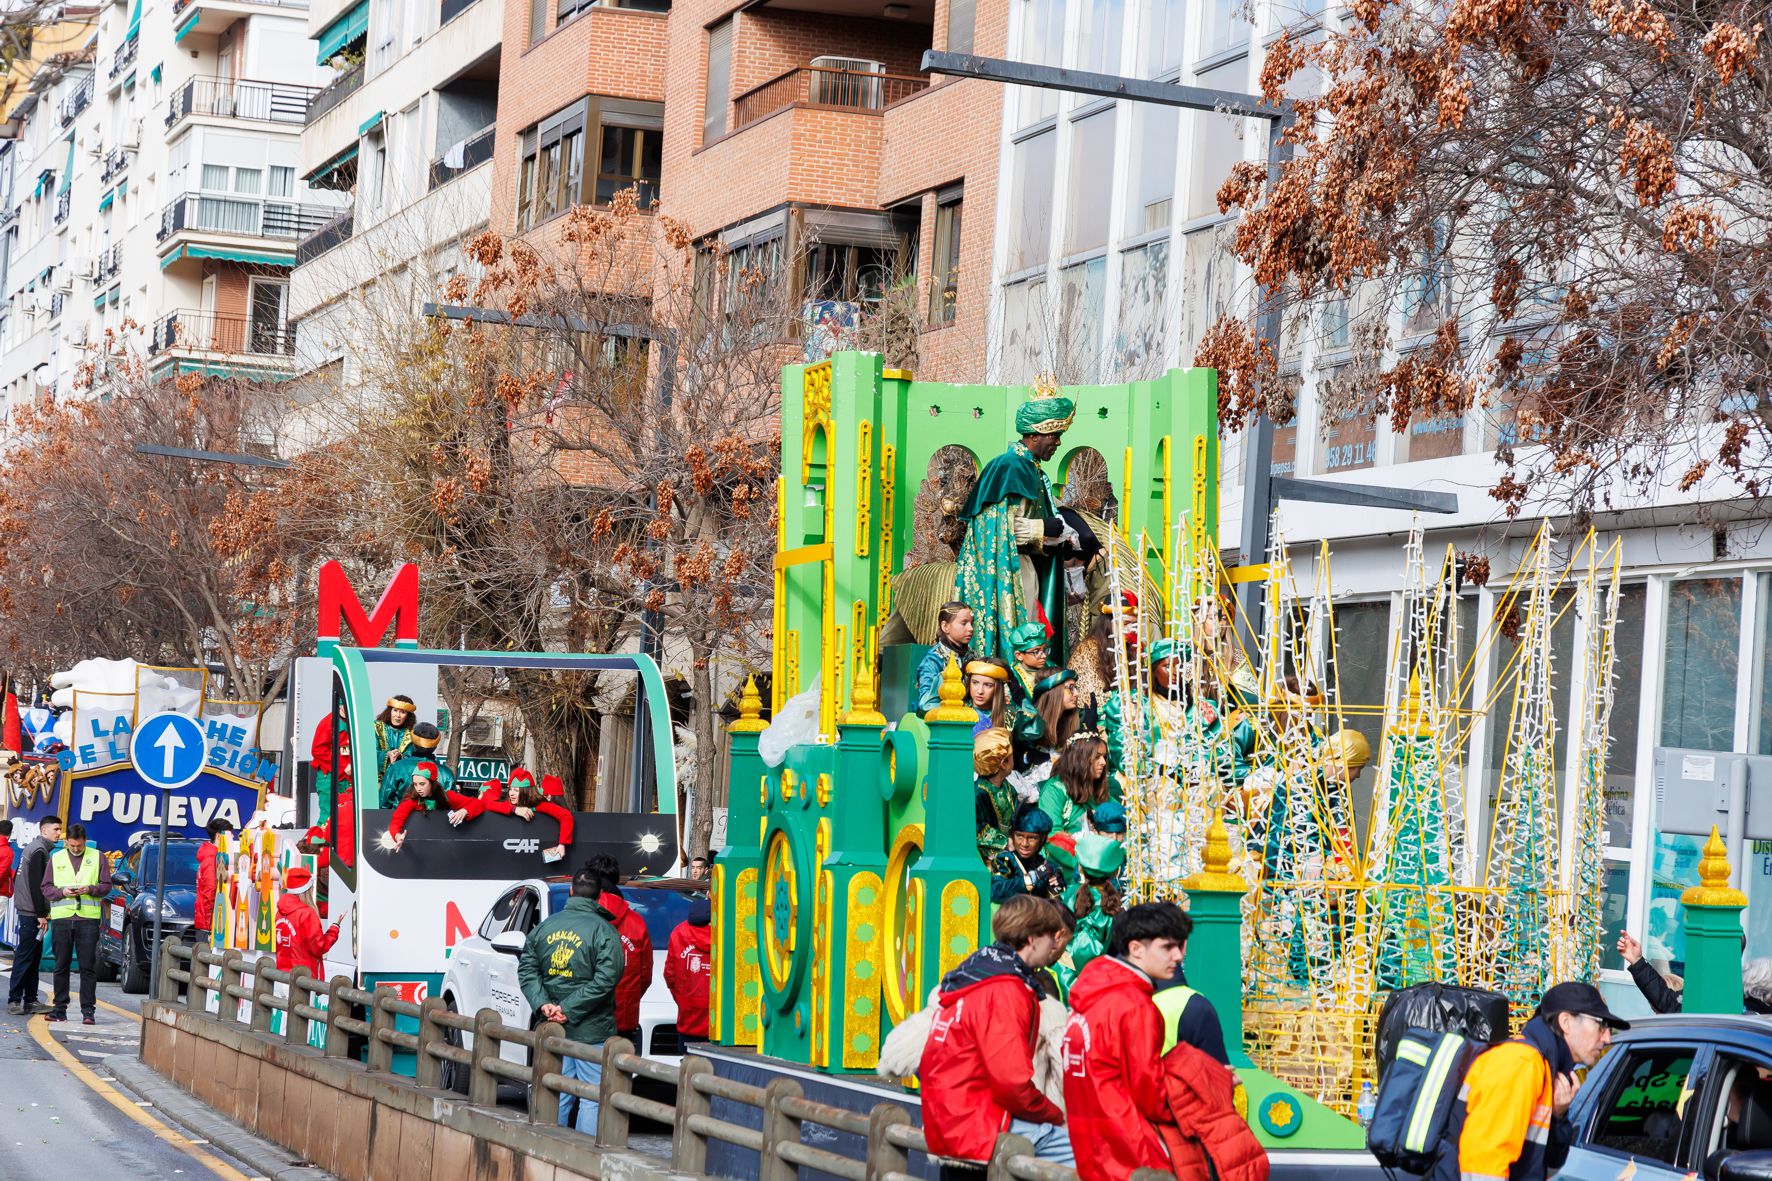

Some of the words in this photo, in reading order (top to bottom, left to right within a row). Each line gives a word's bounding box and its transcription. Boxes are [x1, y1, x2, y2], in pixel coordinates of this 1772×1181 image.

[1341, 444, 1353, 466] 29
[91, 716, 132, 738] LA
[56, 743, 97, 771] DE
[208, 746, 279, 783] SIÓN
[80, 786, 242, 830] PULEVA
[503, 839, 540, 853] CAF
[547, 930, 583, 949] CABALGATA
[492, 988, 520, 1007] PORSCHE
